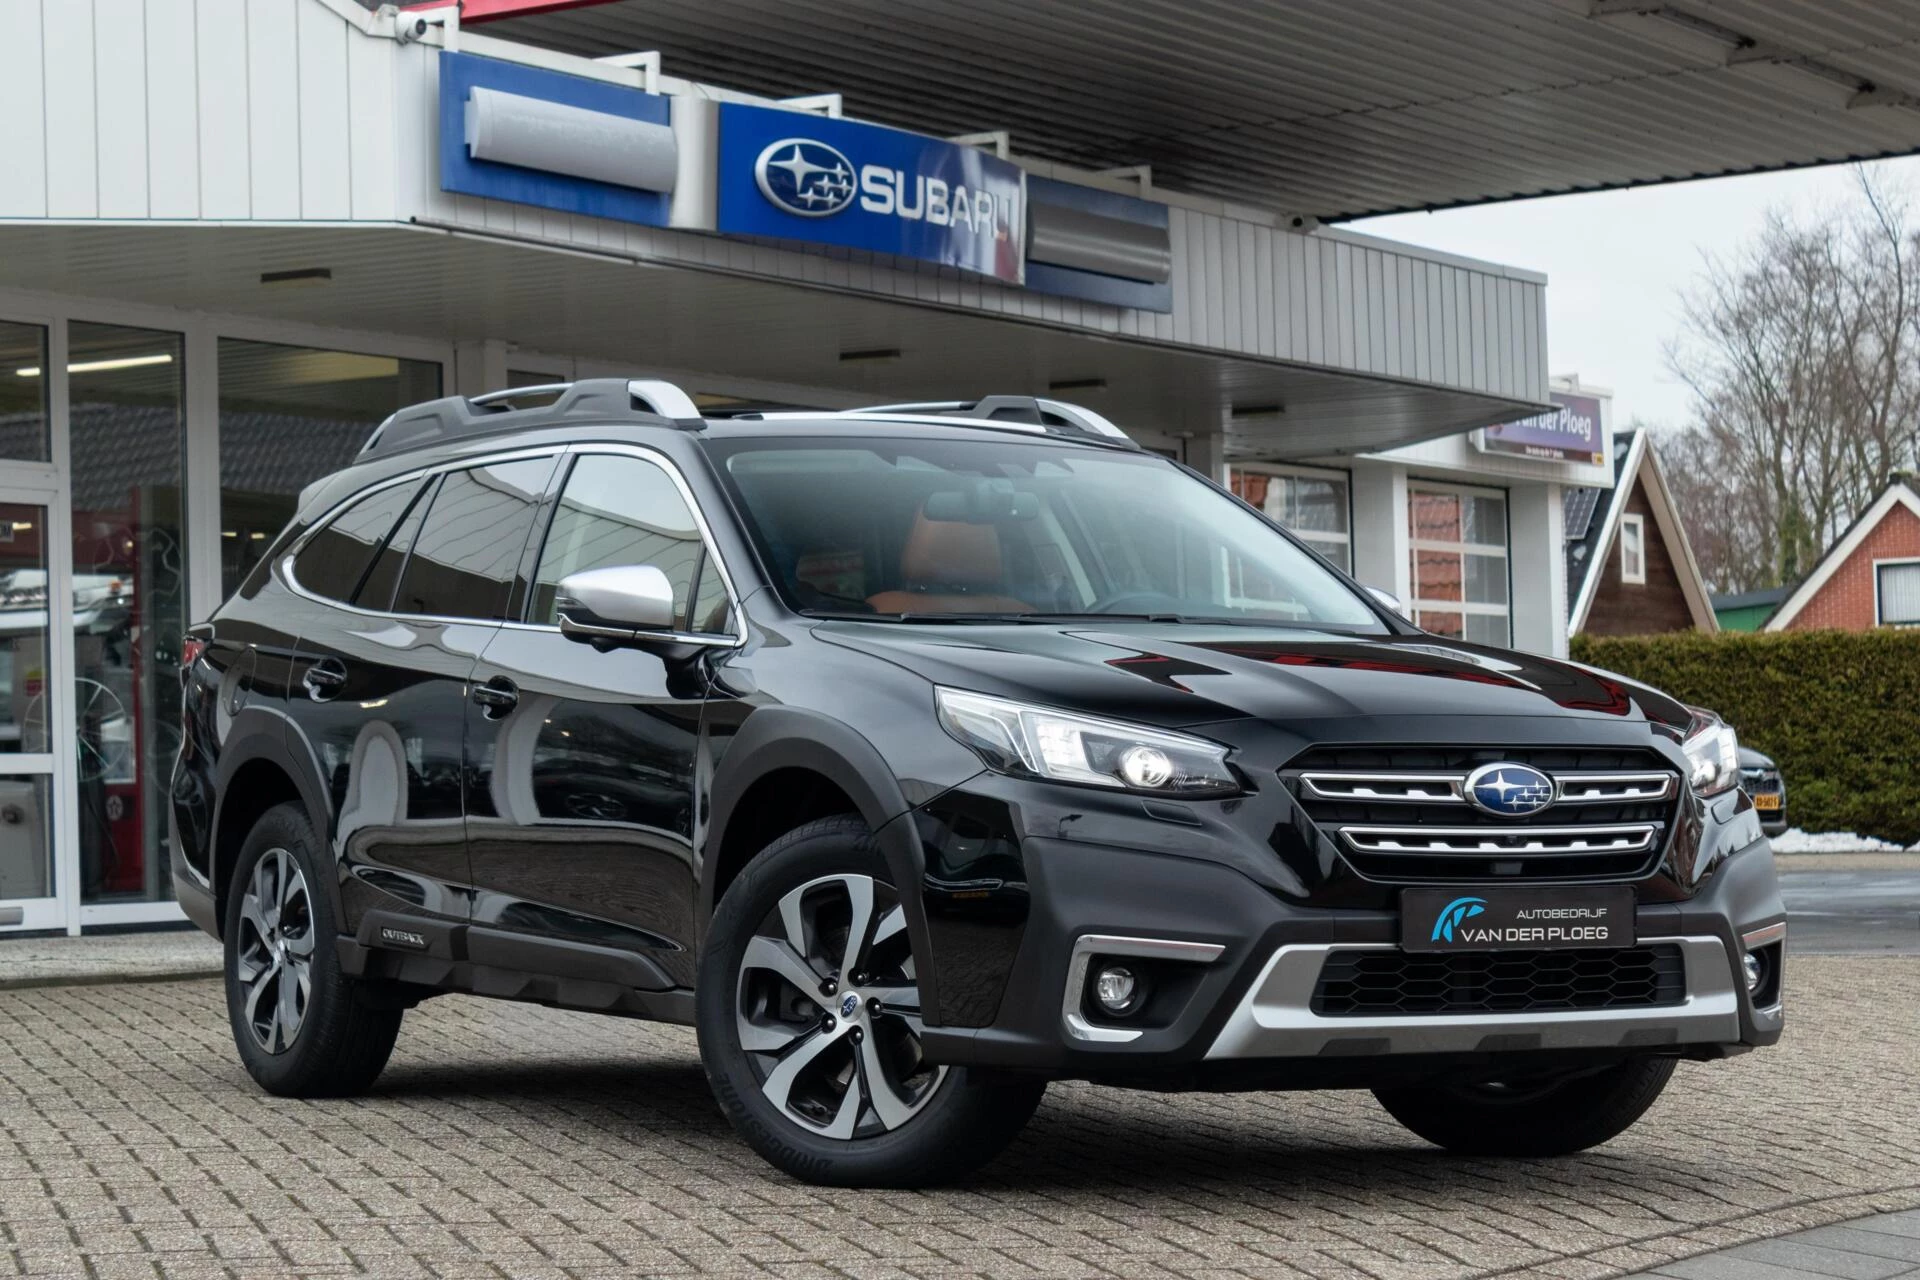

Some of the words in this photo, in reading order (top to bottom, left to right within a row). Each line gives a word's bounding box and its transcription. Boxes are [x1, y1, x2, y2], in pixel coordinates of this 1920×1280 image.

[861, 164, 1012, 241] SUBARU
[1560, 408, 1591, 442] Ploeg
[1516, 908, 1607, 919] AUTOBEDRIJF
[382, 928, 425, 945] OUTBACK
[1461, 929, 1502, 943] VAN
[1506, 928, 1545, 942] DER
[1548, 927, 1609, 941] PLOEG
